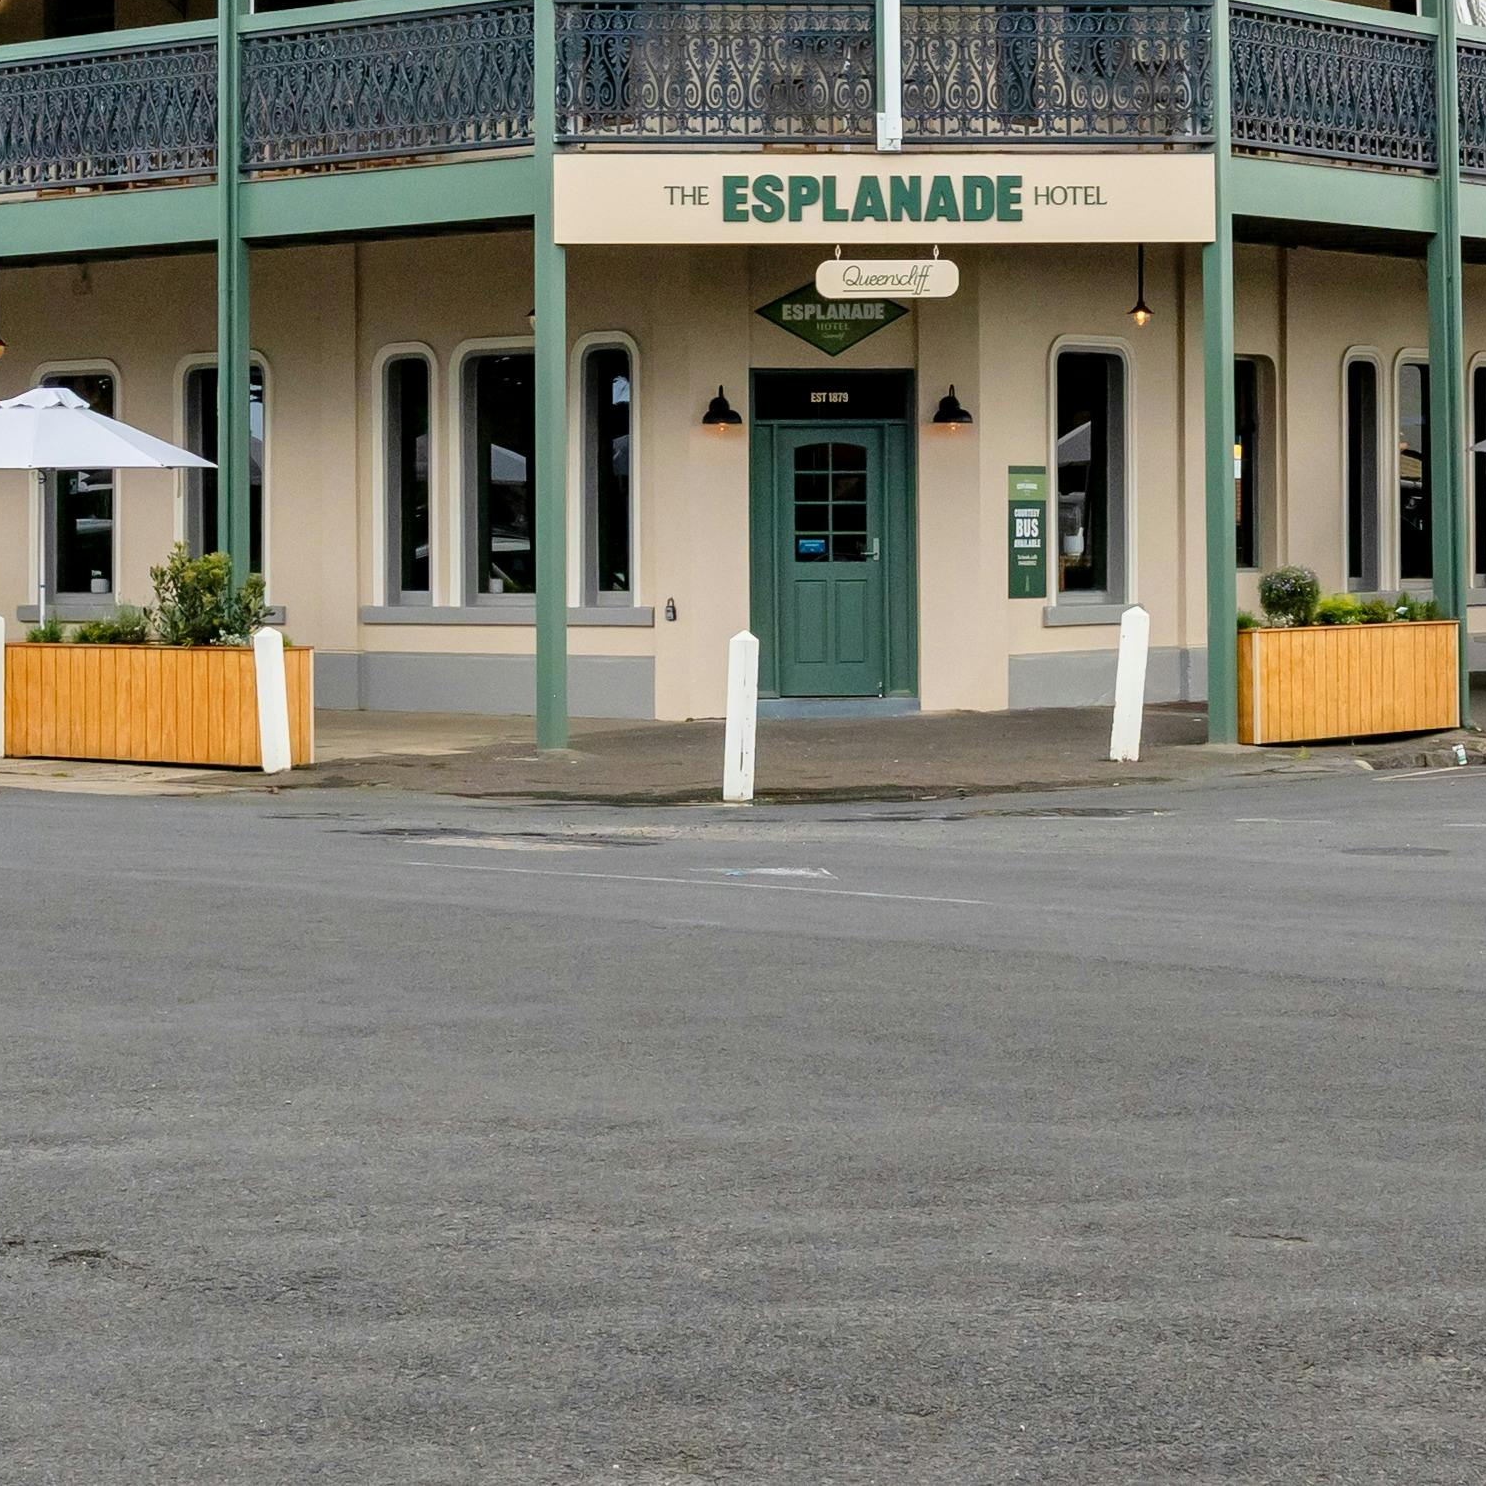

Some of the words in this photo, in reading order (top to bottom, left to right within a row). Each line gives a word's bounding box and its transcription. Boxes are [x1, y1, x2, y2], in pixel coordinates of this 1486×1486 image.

[663, 185, 710, 206] THE
[722, 174, 1024, 223] ESPLANADE
[1033, 185, 1108, 206] HOTEL
[842, 264, 934, 296] Queenscliff
[782, 303, 886, 321] ESPLANADE
[816, 322, 850, 331] HOTEL
[810, 392, 827, 403] EST
[828, 392, 849, 403] 1879
[1015, 518, 1039, 537] BUS
